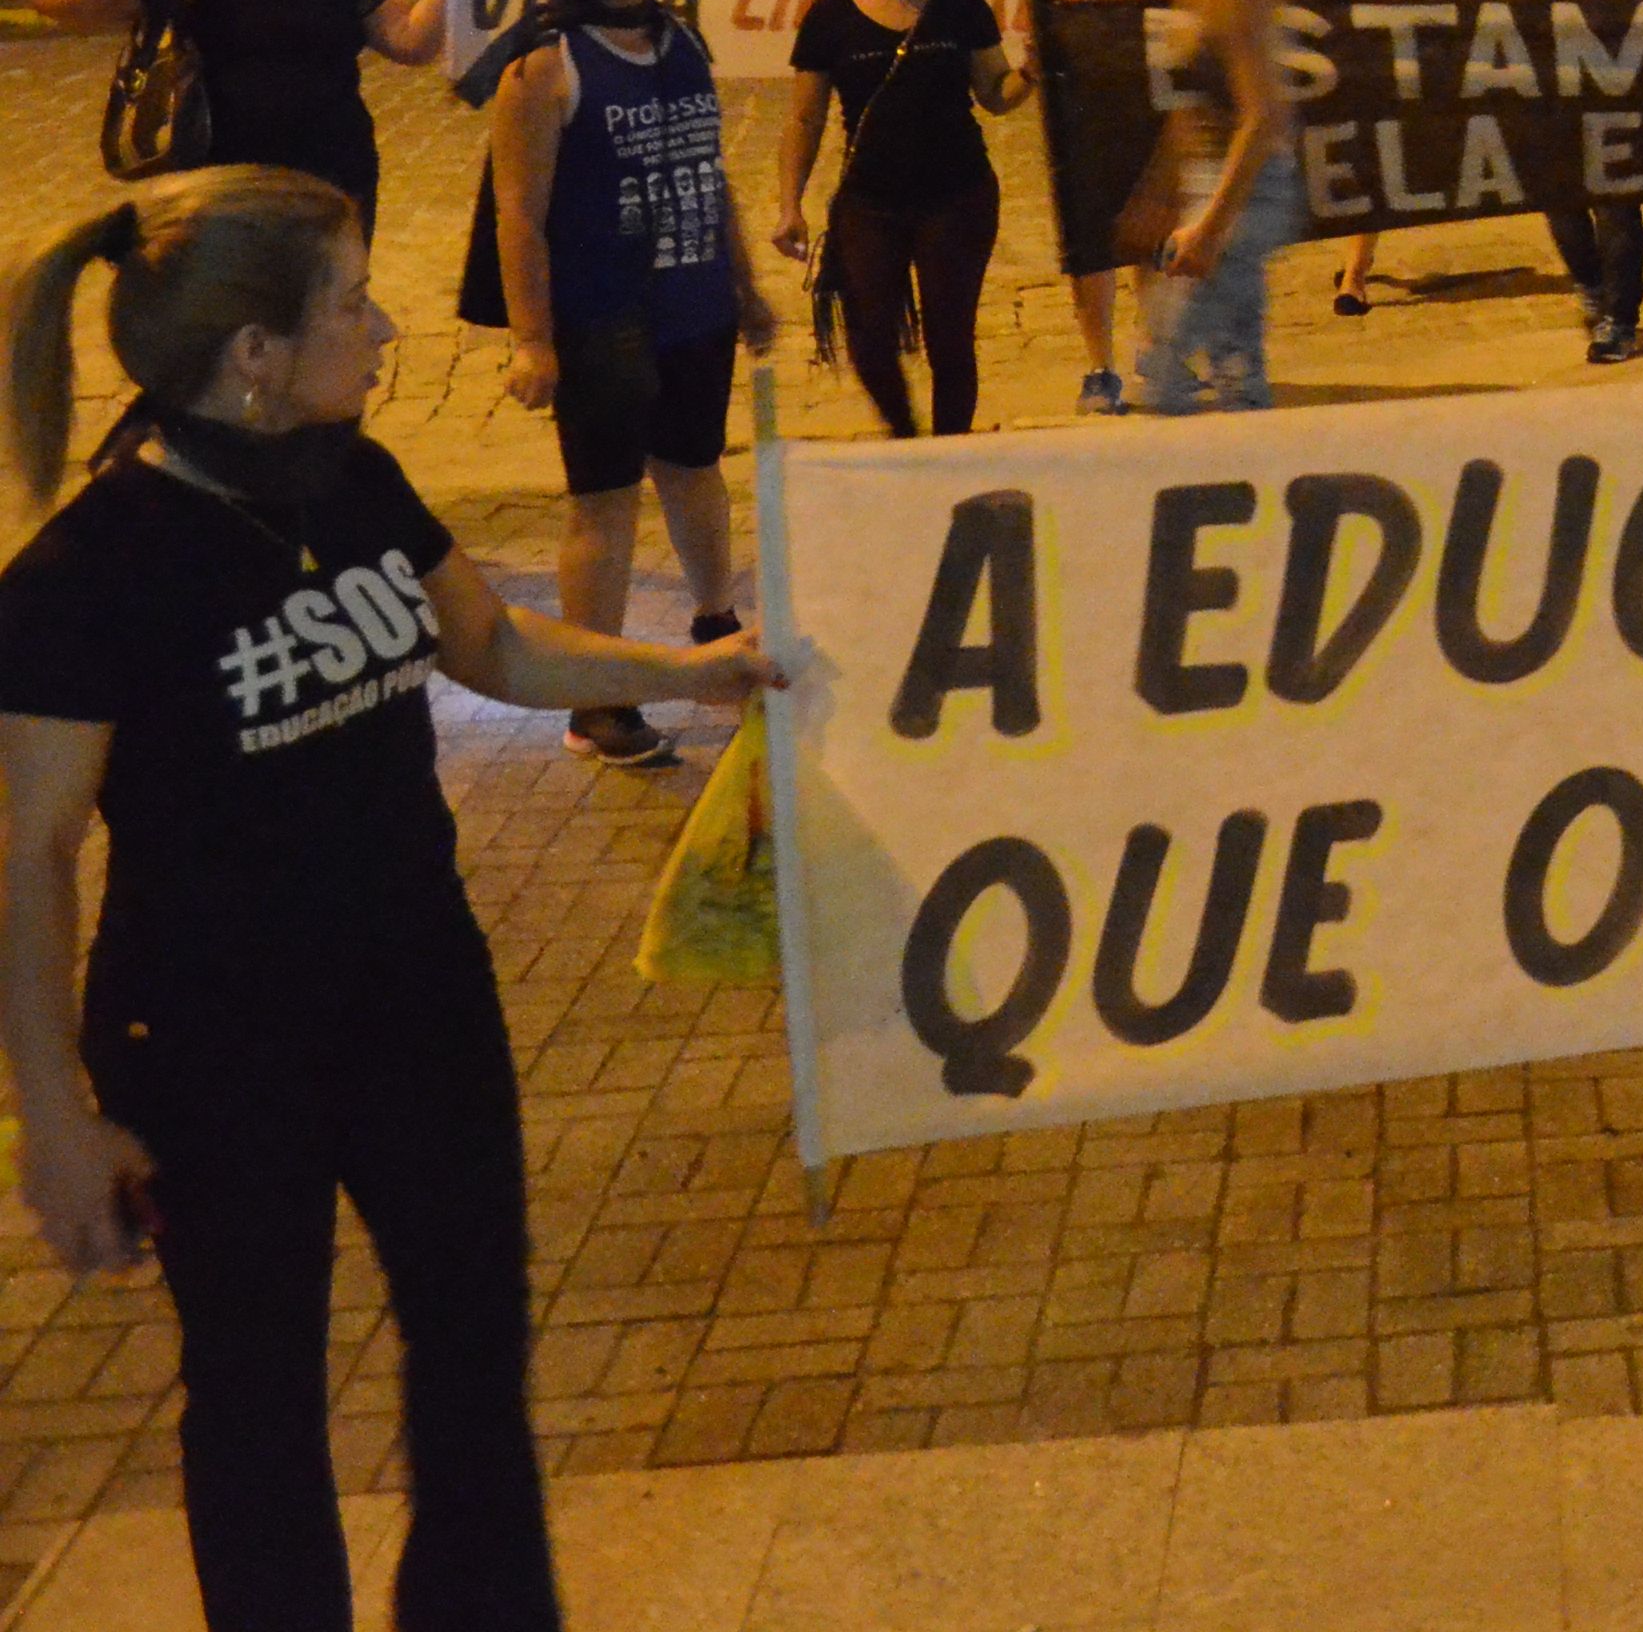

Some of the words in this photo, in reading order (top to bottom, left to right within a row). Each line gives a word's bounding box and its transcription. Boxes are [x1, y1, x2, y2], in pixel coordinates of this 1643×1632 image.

[1303, 113, 1527, 219] ELA
[218, 548, 441, 718] #SOS
[889, 488, 1042, 739] A
[901, 797, 1384, 1100] QUE
